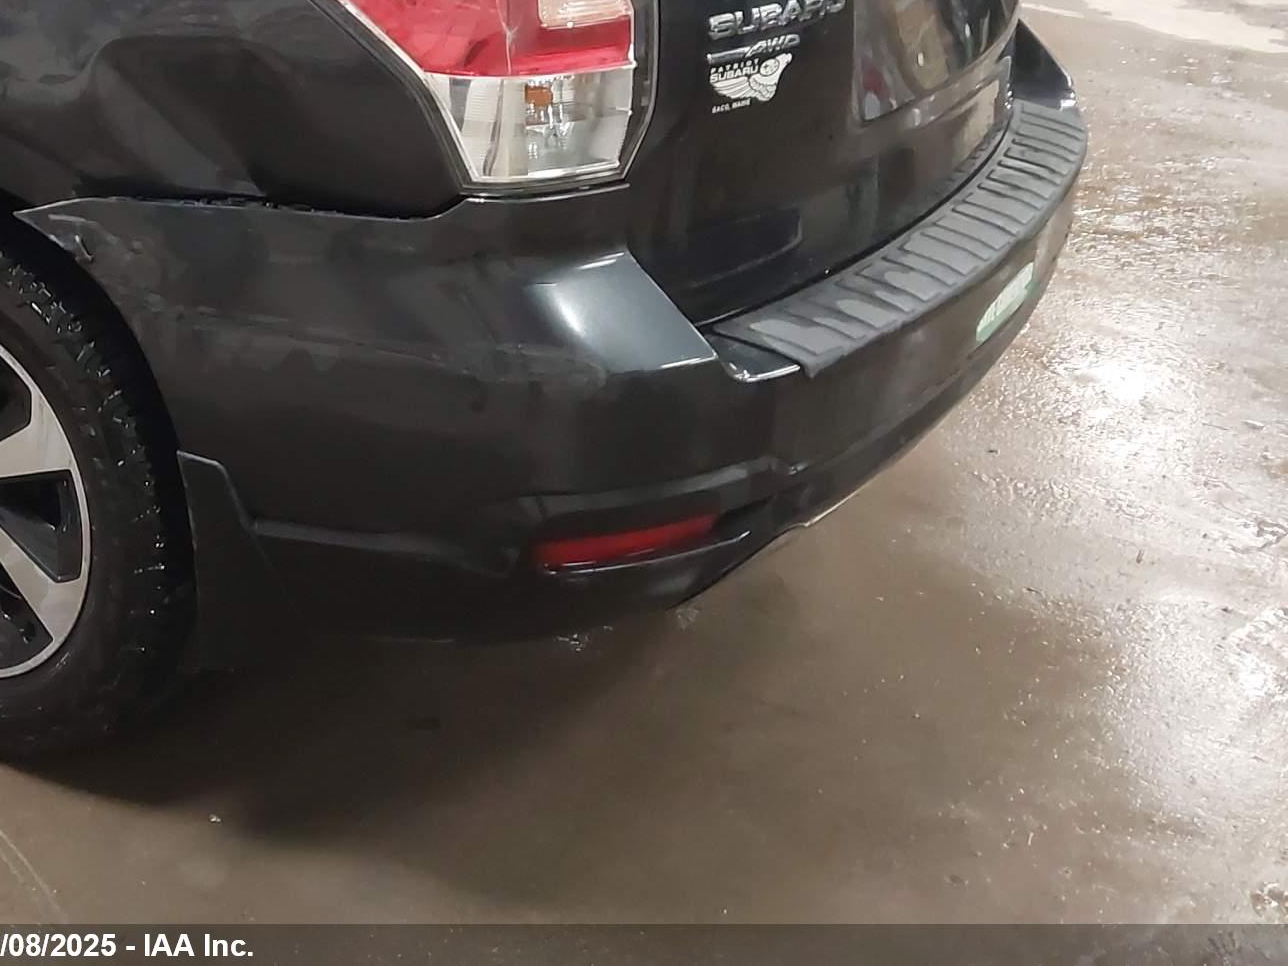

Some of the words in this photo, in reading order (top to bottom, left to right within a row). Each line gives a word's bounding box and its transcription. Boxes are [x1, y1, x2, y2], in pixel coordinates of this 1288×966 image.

[746, 34, 800, 58] AWD
[710, 58, 759, 75] PATRIOT
[710, 64, 759, 83] SUBARU
